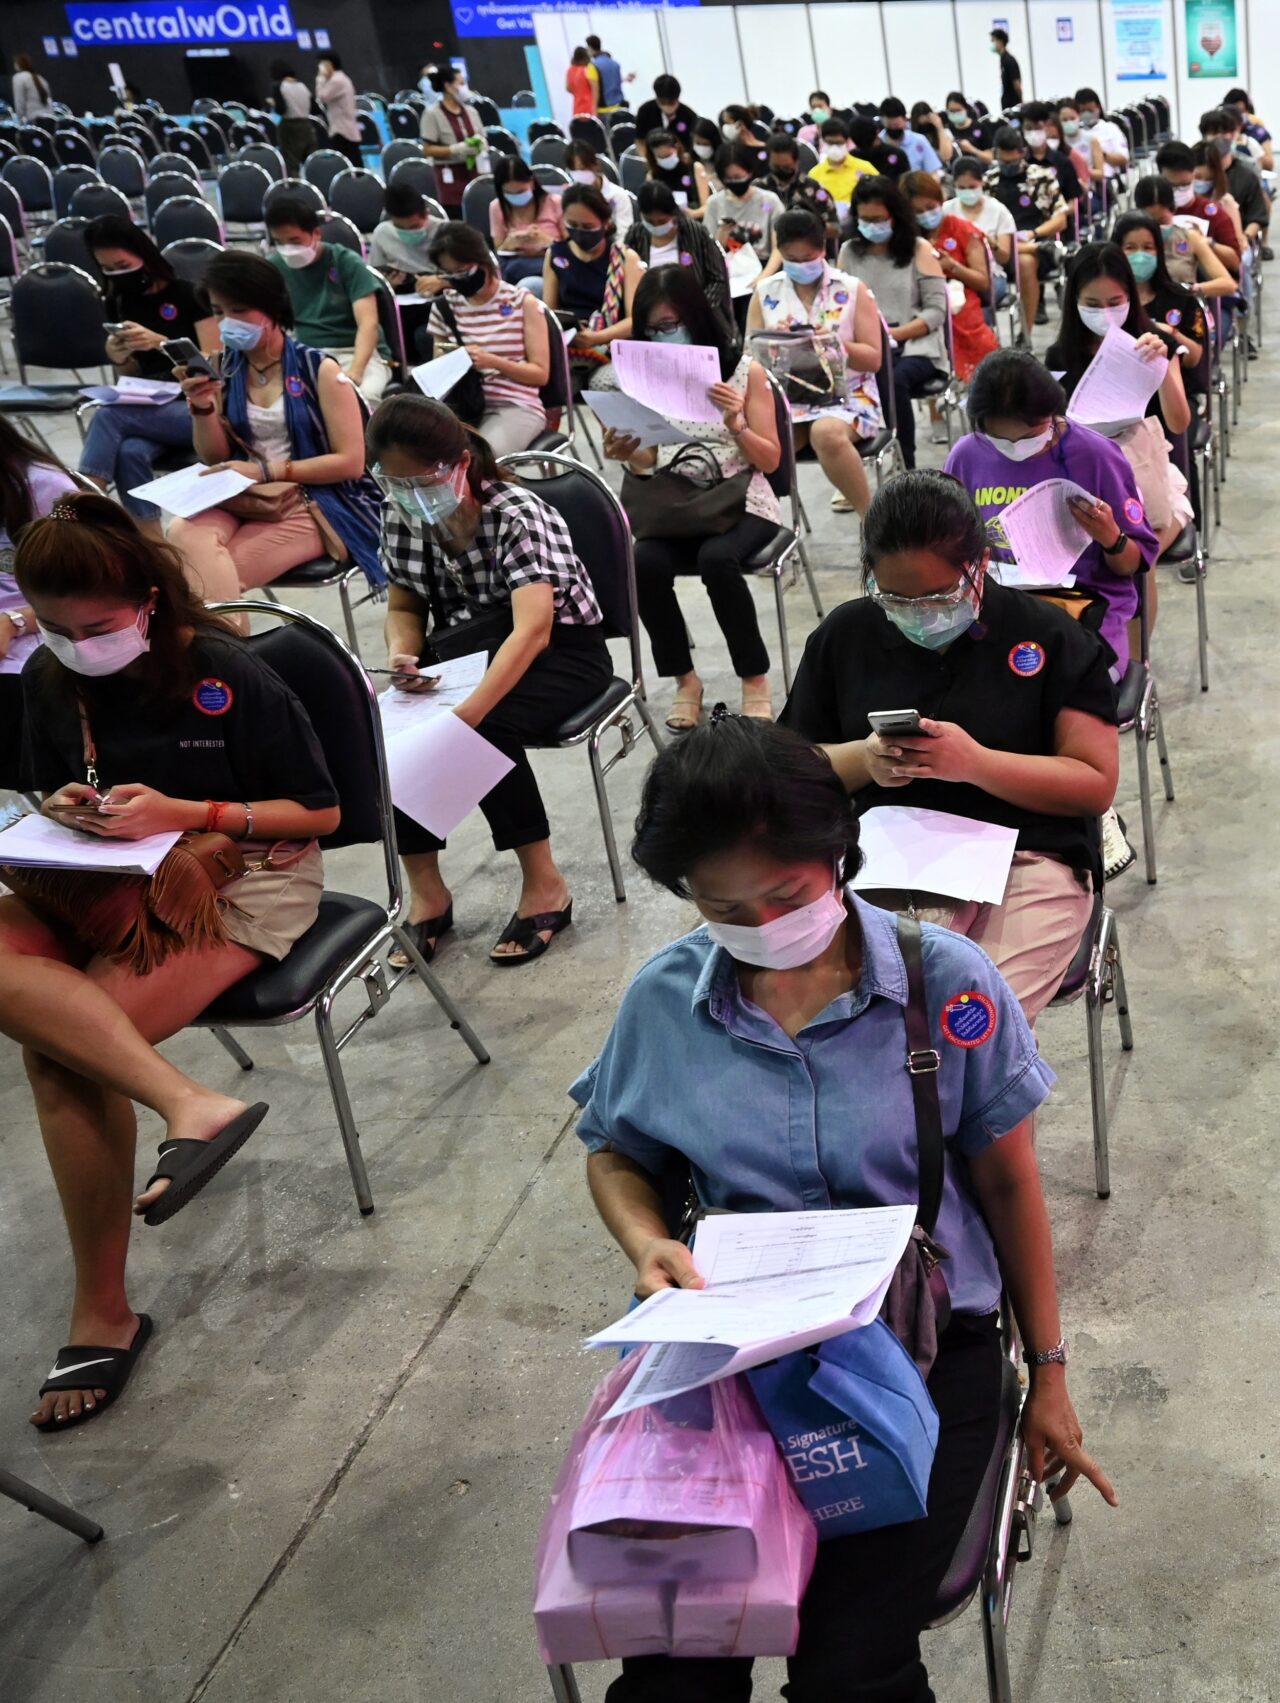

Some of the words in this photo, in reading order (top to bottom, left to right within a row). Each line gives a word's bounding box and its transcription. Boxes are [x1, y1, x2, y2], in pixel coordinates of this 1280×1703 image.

[73, 5, 293, 40] centralwOrld
[180, 740, 190, 748] NOT
[787, 1420, 858, 1449] Signature
